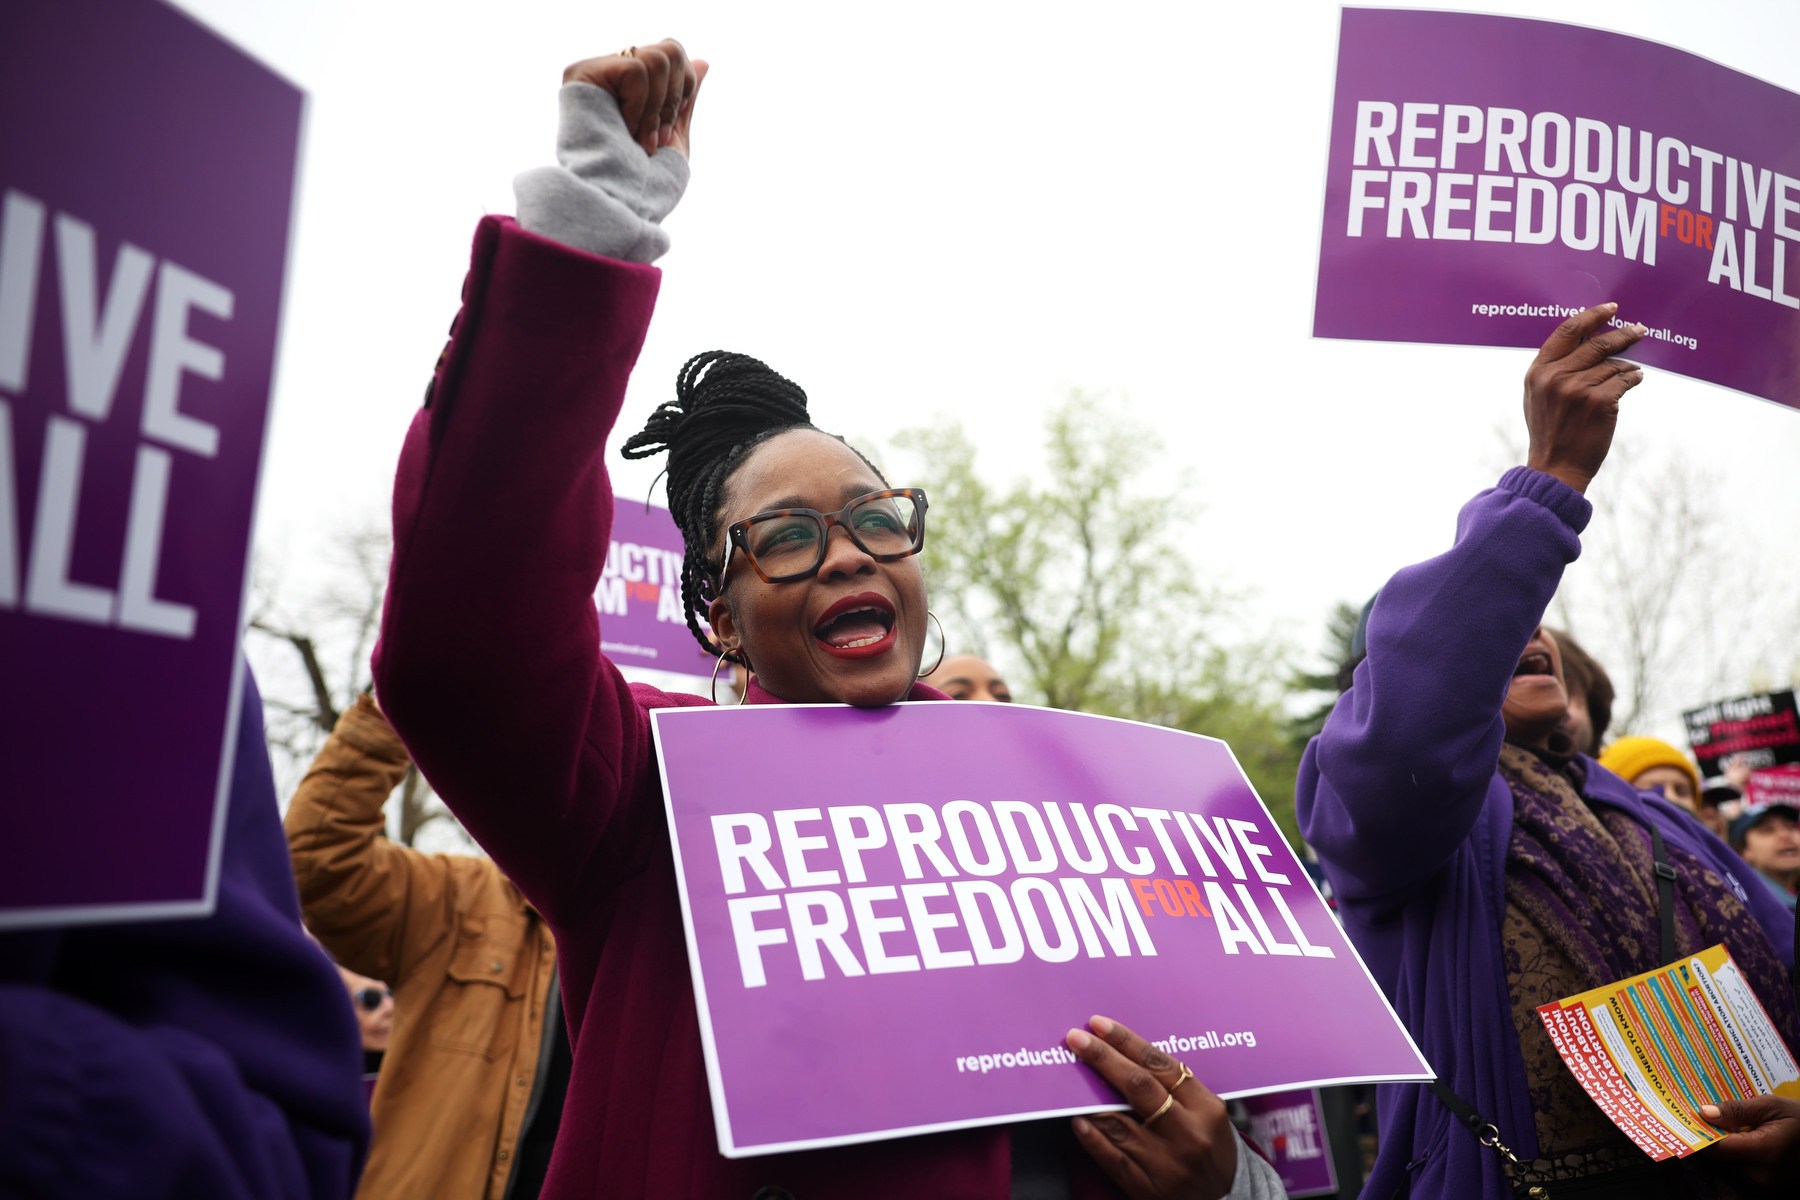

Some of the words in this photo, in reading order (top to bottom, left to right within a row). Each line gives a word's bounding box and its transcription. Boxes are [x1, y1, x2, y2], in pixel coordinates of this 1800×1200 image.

[1353, 101, 1800, 242] REPRODUCTIVE
[1347, 169, 1658, 267] FREEDOM
[1659, 204, 1714, 251] FOR
[1707, 220, 1800, 309] ALL
[0, 187, 236, 459] IVE
[710, 800, 1292, 894] REPRODUCTIVE
[727, 877, 1158, 989] FREEDOM
[1130, 878, 1212, 918] FOR
[1203, 881, 1337, 959] ALL
[1693, 963, 1718, 1003] ABORTION?
[1540, 1012, 1568, 1053] ABOUT
[1563, 1010, 1592, 1051] ABOUT
[1609, 997, 1629, 1029] KNOW
[1716, 1005, 1744, 1053] MEDICATION
[1551, 1009, 1596, 1078] ABORTION!
[1574, 1007, 1618, 1075] ABORTION!
[1625, 1029, 1636, 1044] TO
[1564, 1055, 1597, 1097] FACTS
[1588, 1054, 1620, 1095] FACTS
[1634, 1045, 1652, 1072] NEED
[1741, 1053, 1762, 1087] CHOOSE
[1650, 1073, 1665, 1095] YOU
[1592, 1080, 1664, 1153] MEDICATION
[1595, 1097, 1616, 1121] THE
[1615, 1078, 1687, 1150] MEDICATION
[1618, 1096, 1639, 1119] THE
[1665, 1098, 1691, 1125] WHAT
[1616, 1121, 1658, 1158] LEARN
[1640, 1119, 1683, 1154] LEARN
